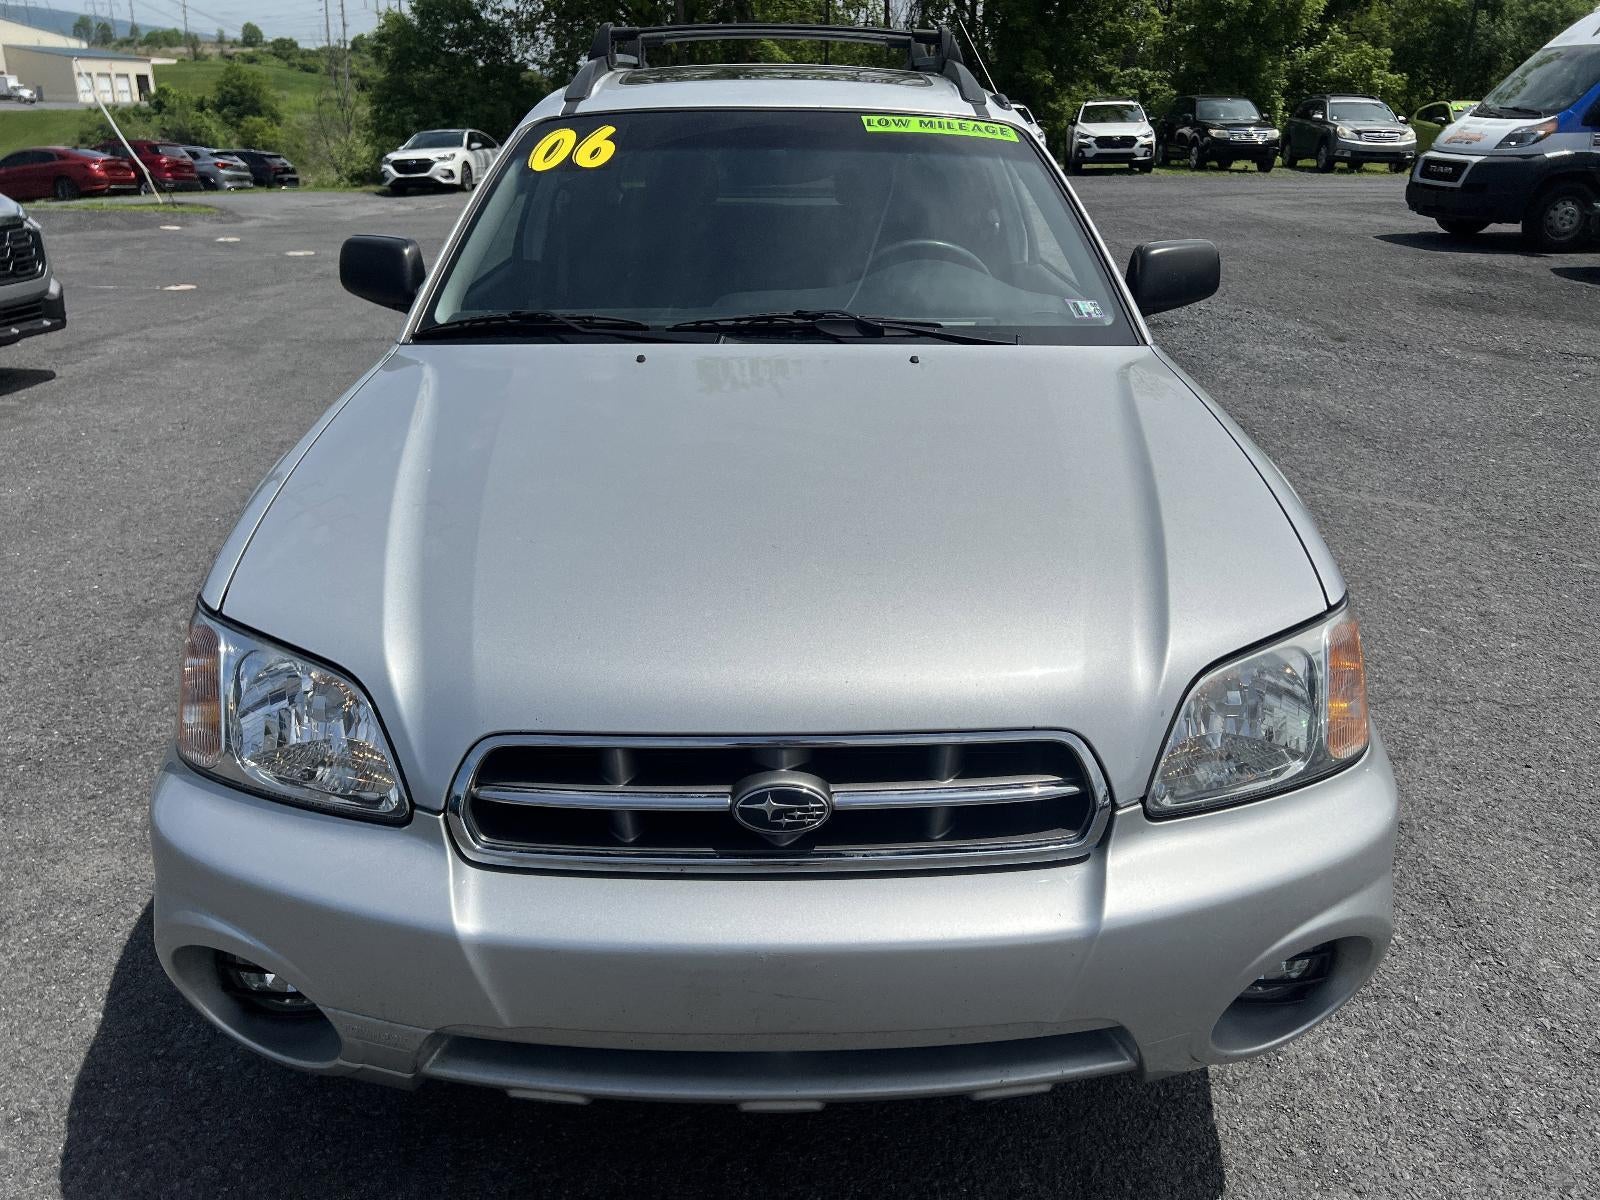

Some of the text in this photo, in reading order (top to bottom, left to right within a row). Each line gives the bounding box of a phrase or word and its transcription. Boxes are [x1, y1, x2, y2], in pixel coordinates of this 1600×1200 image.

[866, 117, 1011, 137] LOW MILEAGE
[527, 124, 617, 172] 06
